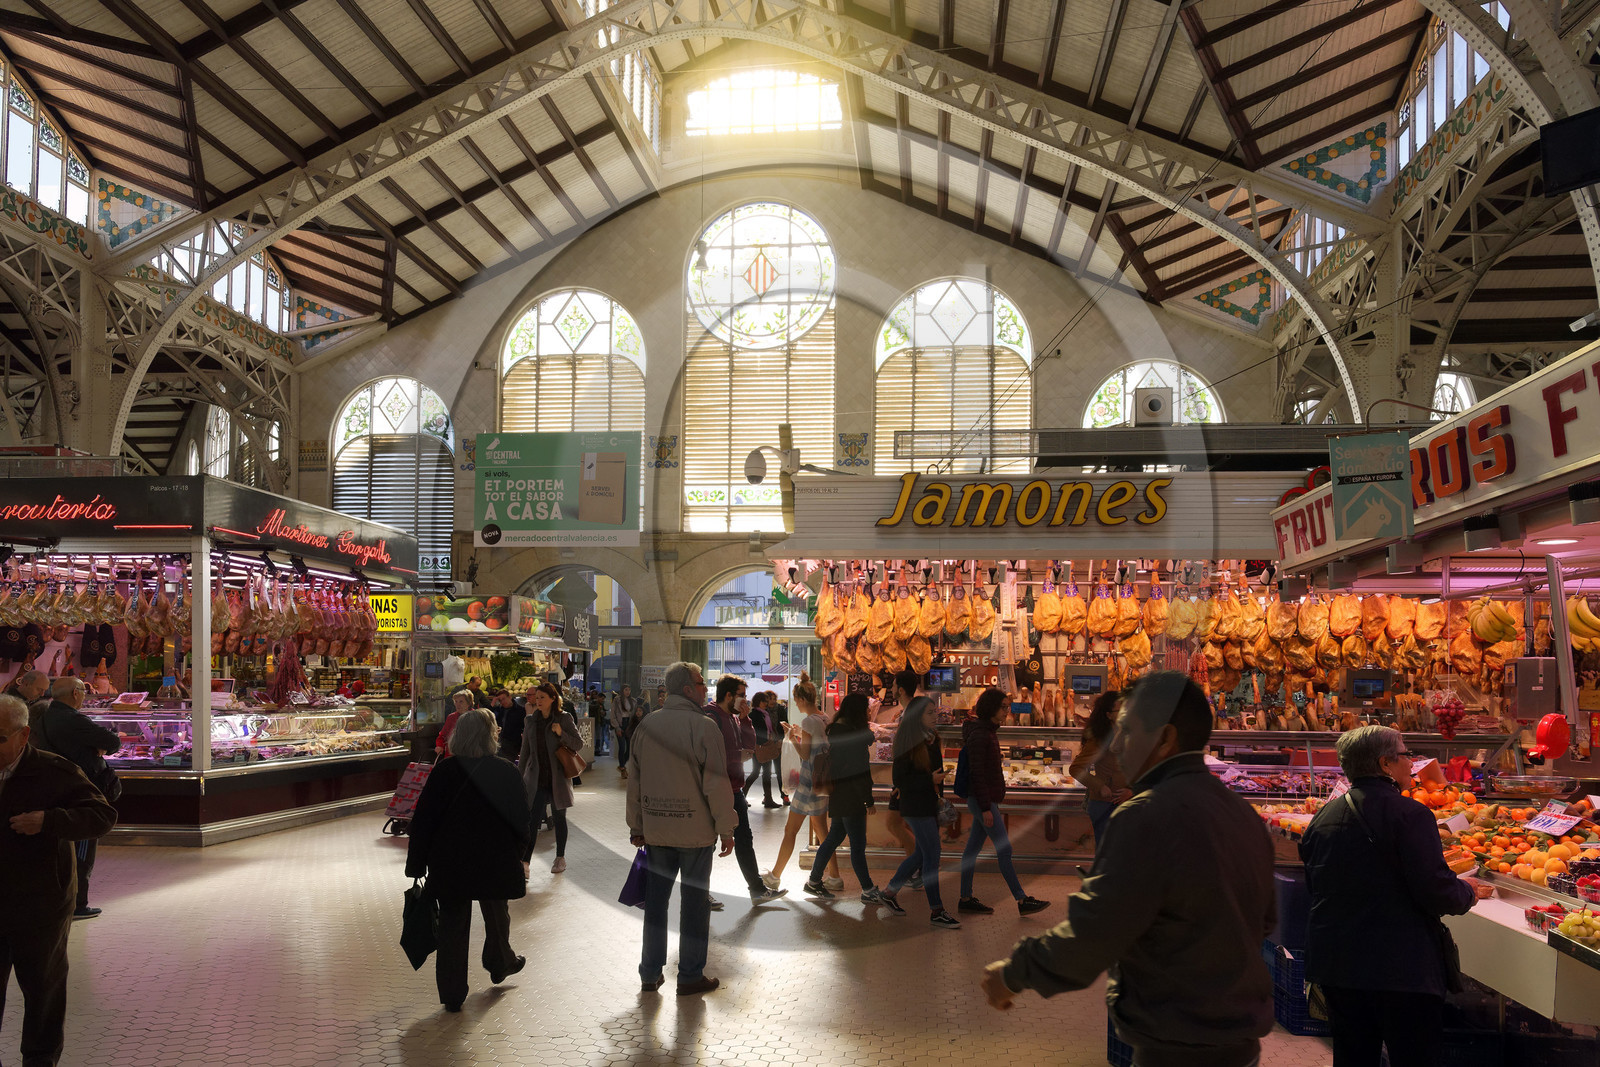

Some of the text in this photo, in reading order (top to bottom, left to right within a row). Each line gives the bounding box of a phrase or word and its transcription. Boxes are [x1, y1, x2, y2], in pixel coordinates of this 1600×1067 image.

[484, 470, 492, 478] si
[1376, 473, 1397, 481] EUROPA
[149, 484, 168, 492] Palcos
[484, 479, 564, 491] ET PORTEM
[484, 492, 564, 501] TOT EL SABOR
[875, 471, 1174, 527] Jamones
[484, 502, 564, 521] A CASA
[483, 530, 500, 540] NOVA
[504, 534, 618, 543] mercadocentralvalencia.es
